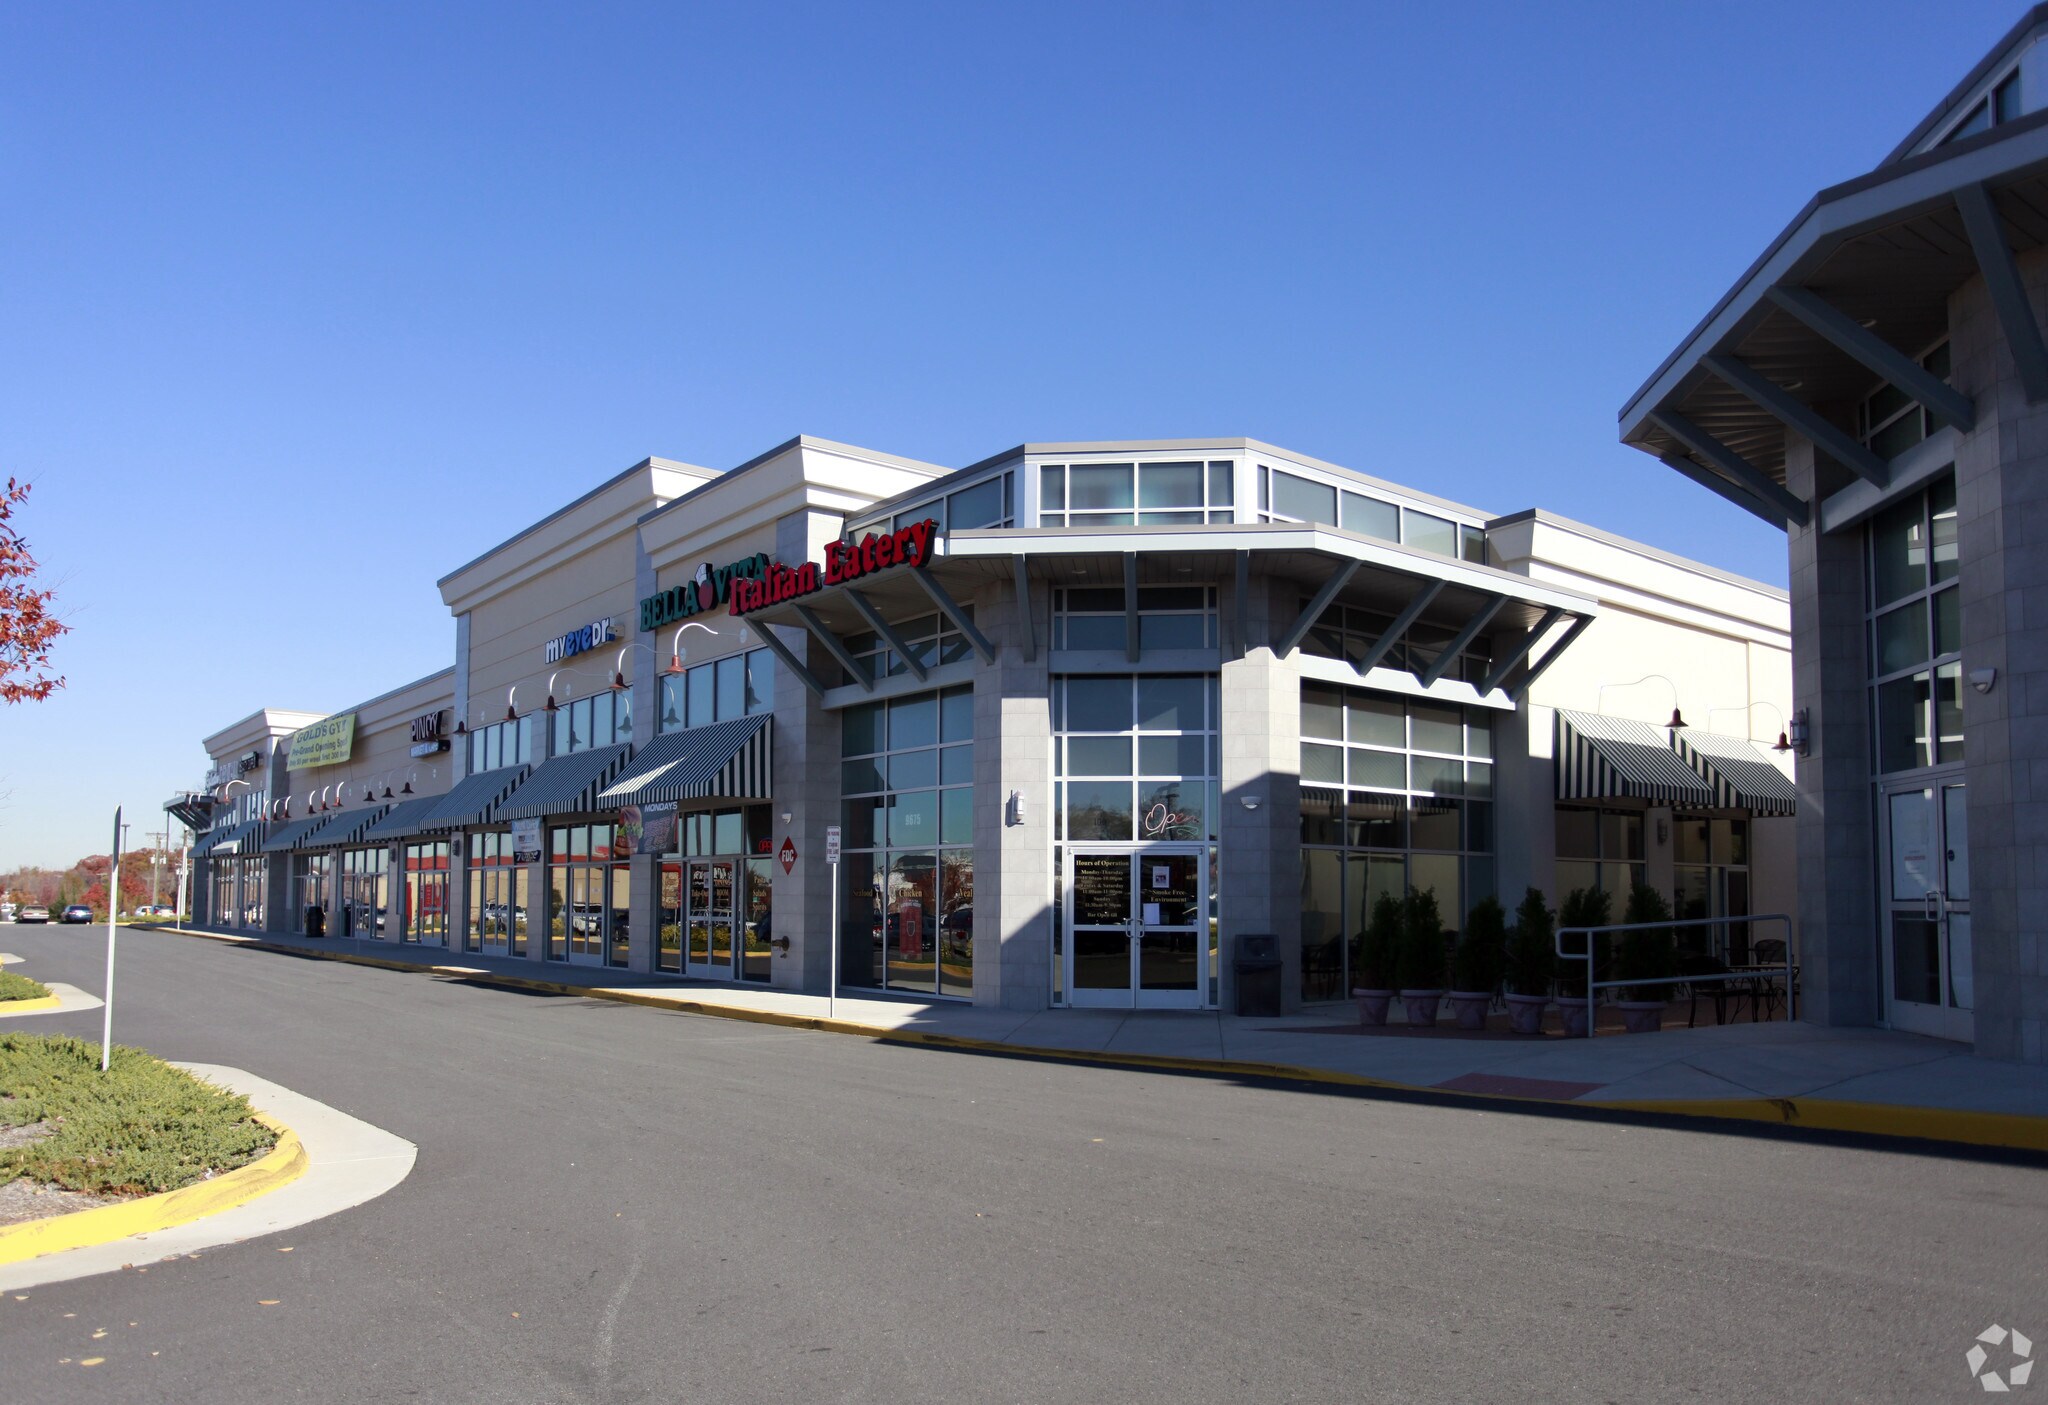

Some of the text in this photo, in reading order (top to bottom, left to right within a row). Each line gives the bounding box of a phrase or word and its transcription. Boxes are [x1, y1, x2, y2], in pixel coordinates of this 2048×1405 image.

[729, 518, 938, 616] Italian Eatery
[640, 580, 699, 632] BELLA
[297, 723, 328, 743] GOLD'S
[644, 801, 678, 812] MONDAYS
[905, 814, 921, 825] 9675
[1146, 803, 1198, 833] Open
[781, 849, 794, 862] FDC
[899, 888, 922, 897] Chicken
[959, 888, 973, 897] Veal
